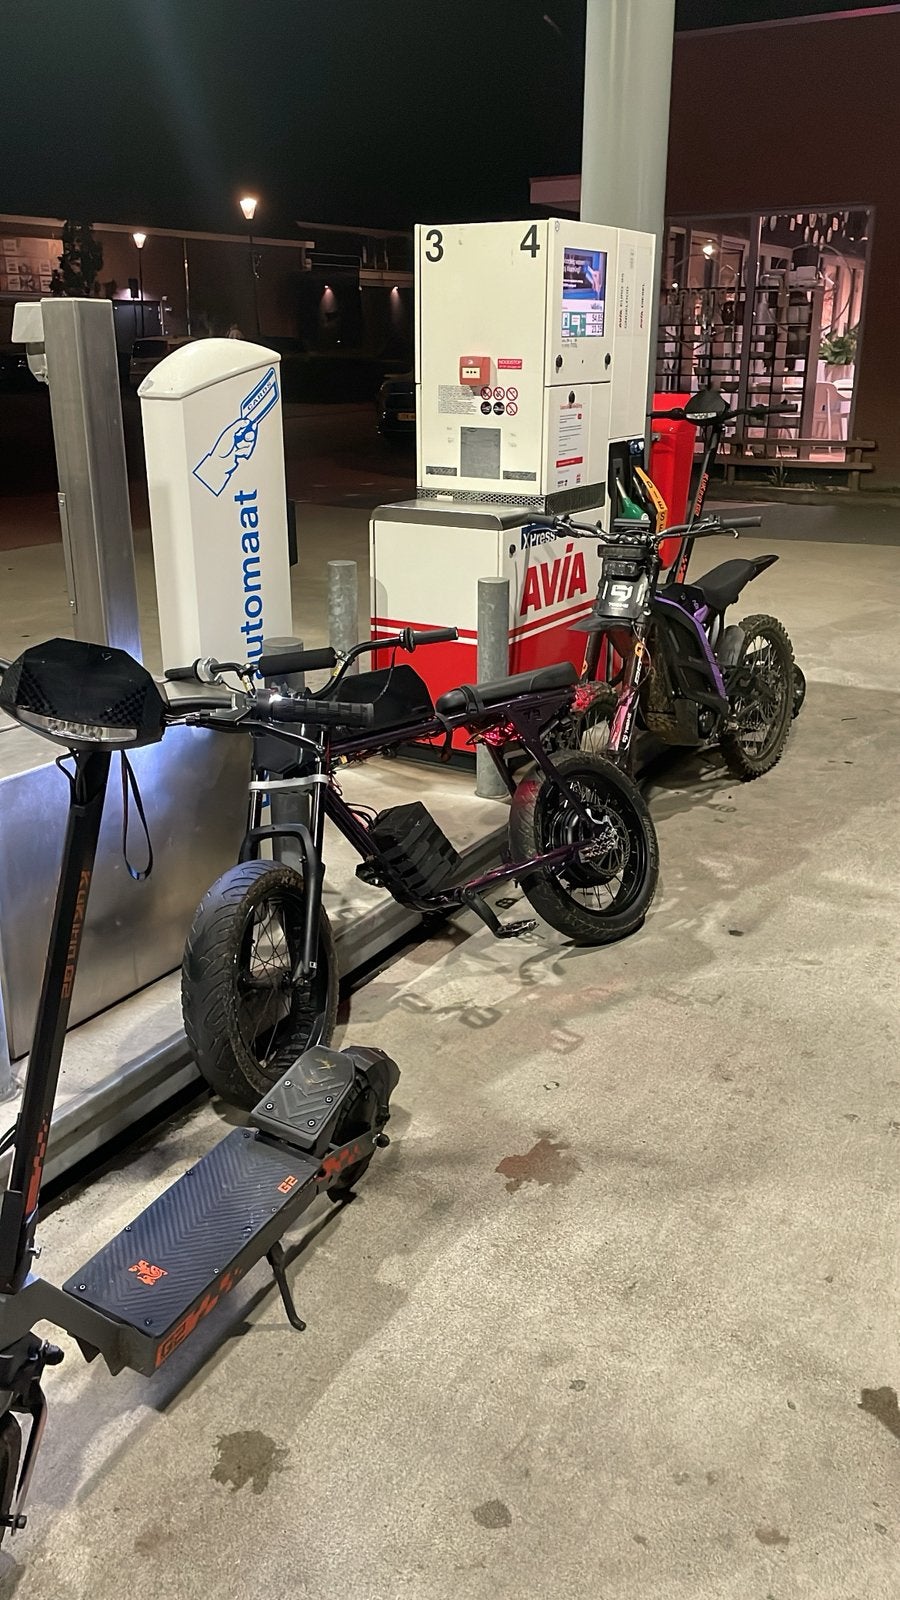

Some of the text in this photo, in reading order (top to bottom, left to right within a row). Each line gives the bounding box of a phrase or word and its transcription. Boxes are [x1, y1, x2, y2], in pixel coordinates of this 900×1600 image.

[425, 229, 444, 262] 3
[520, 224, 540, 258] 4
[247, 381, 272, 411] CARDS
[646, 480, 665, 530] DIESE
[61, 869, 92, 999] KUKIRIN G2
[277, 1175, 299, 1194] G2
